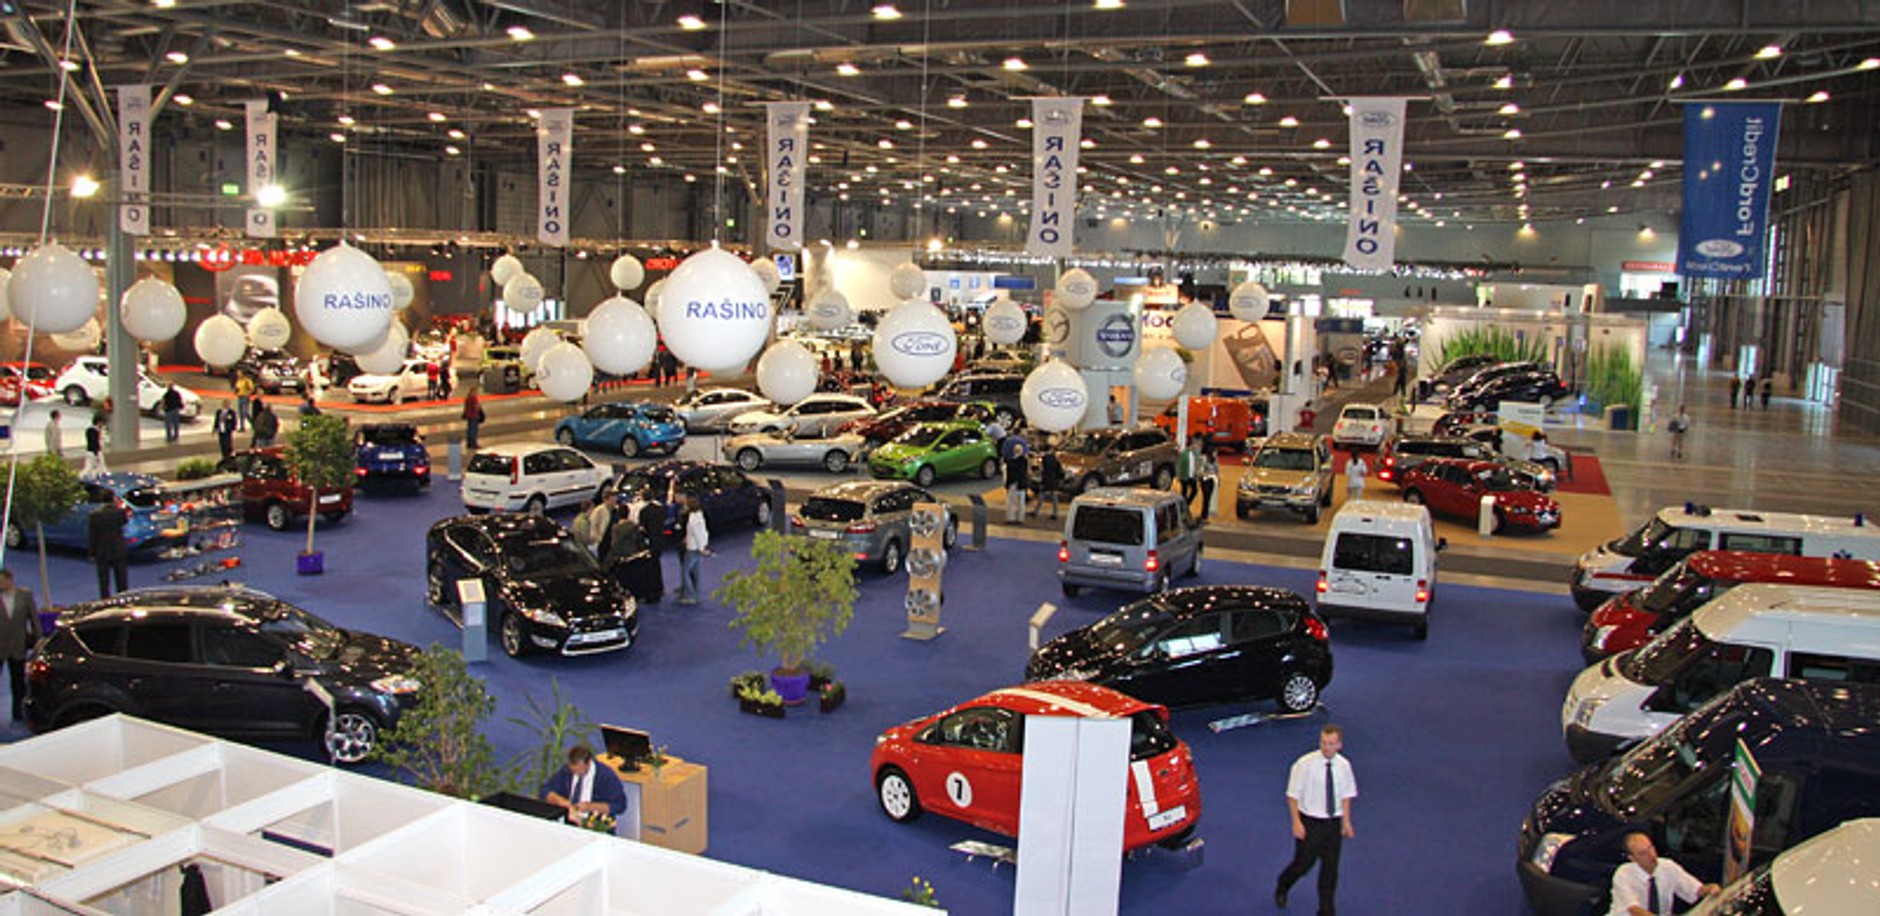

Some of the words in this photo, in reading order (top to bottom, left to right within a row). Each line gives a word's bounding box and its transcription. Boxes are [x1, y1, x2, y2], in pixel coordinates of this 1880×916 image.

[324, 291, 392, 309] RAŠINO
[686, 298, 767, 320] RAŠINO
[899, 334, 943, 353] Ford
[953, 777, 963, 800] 7
